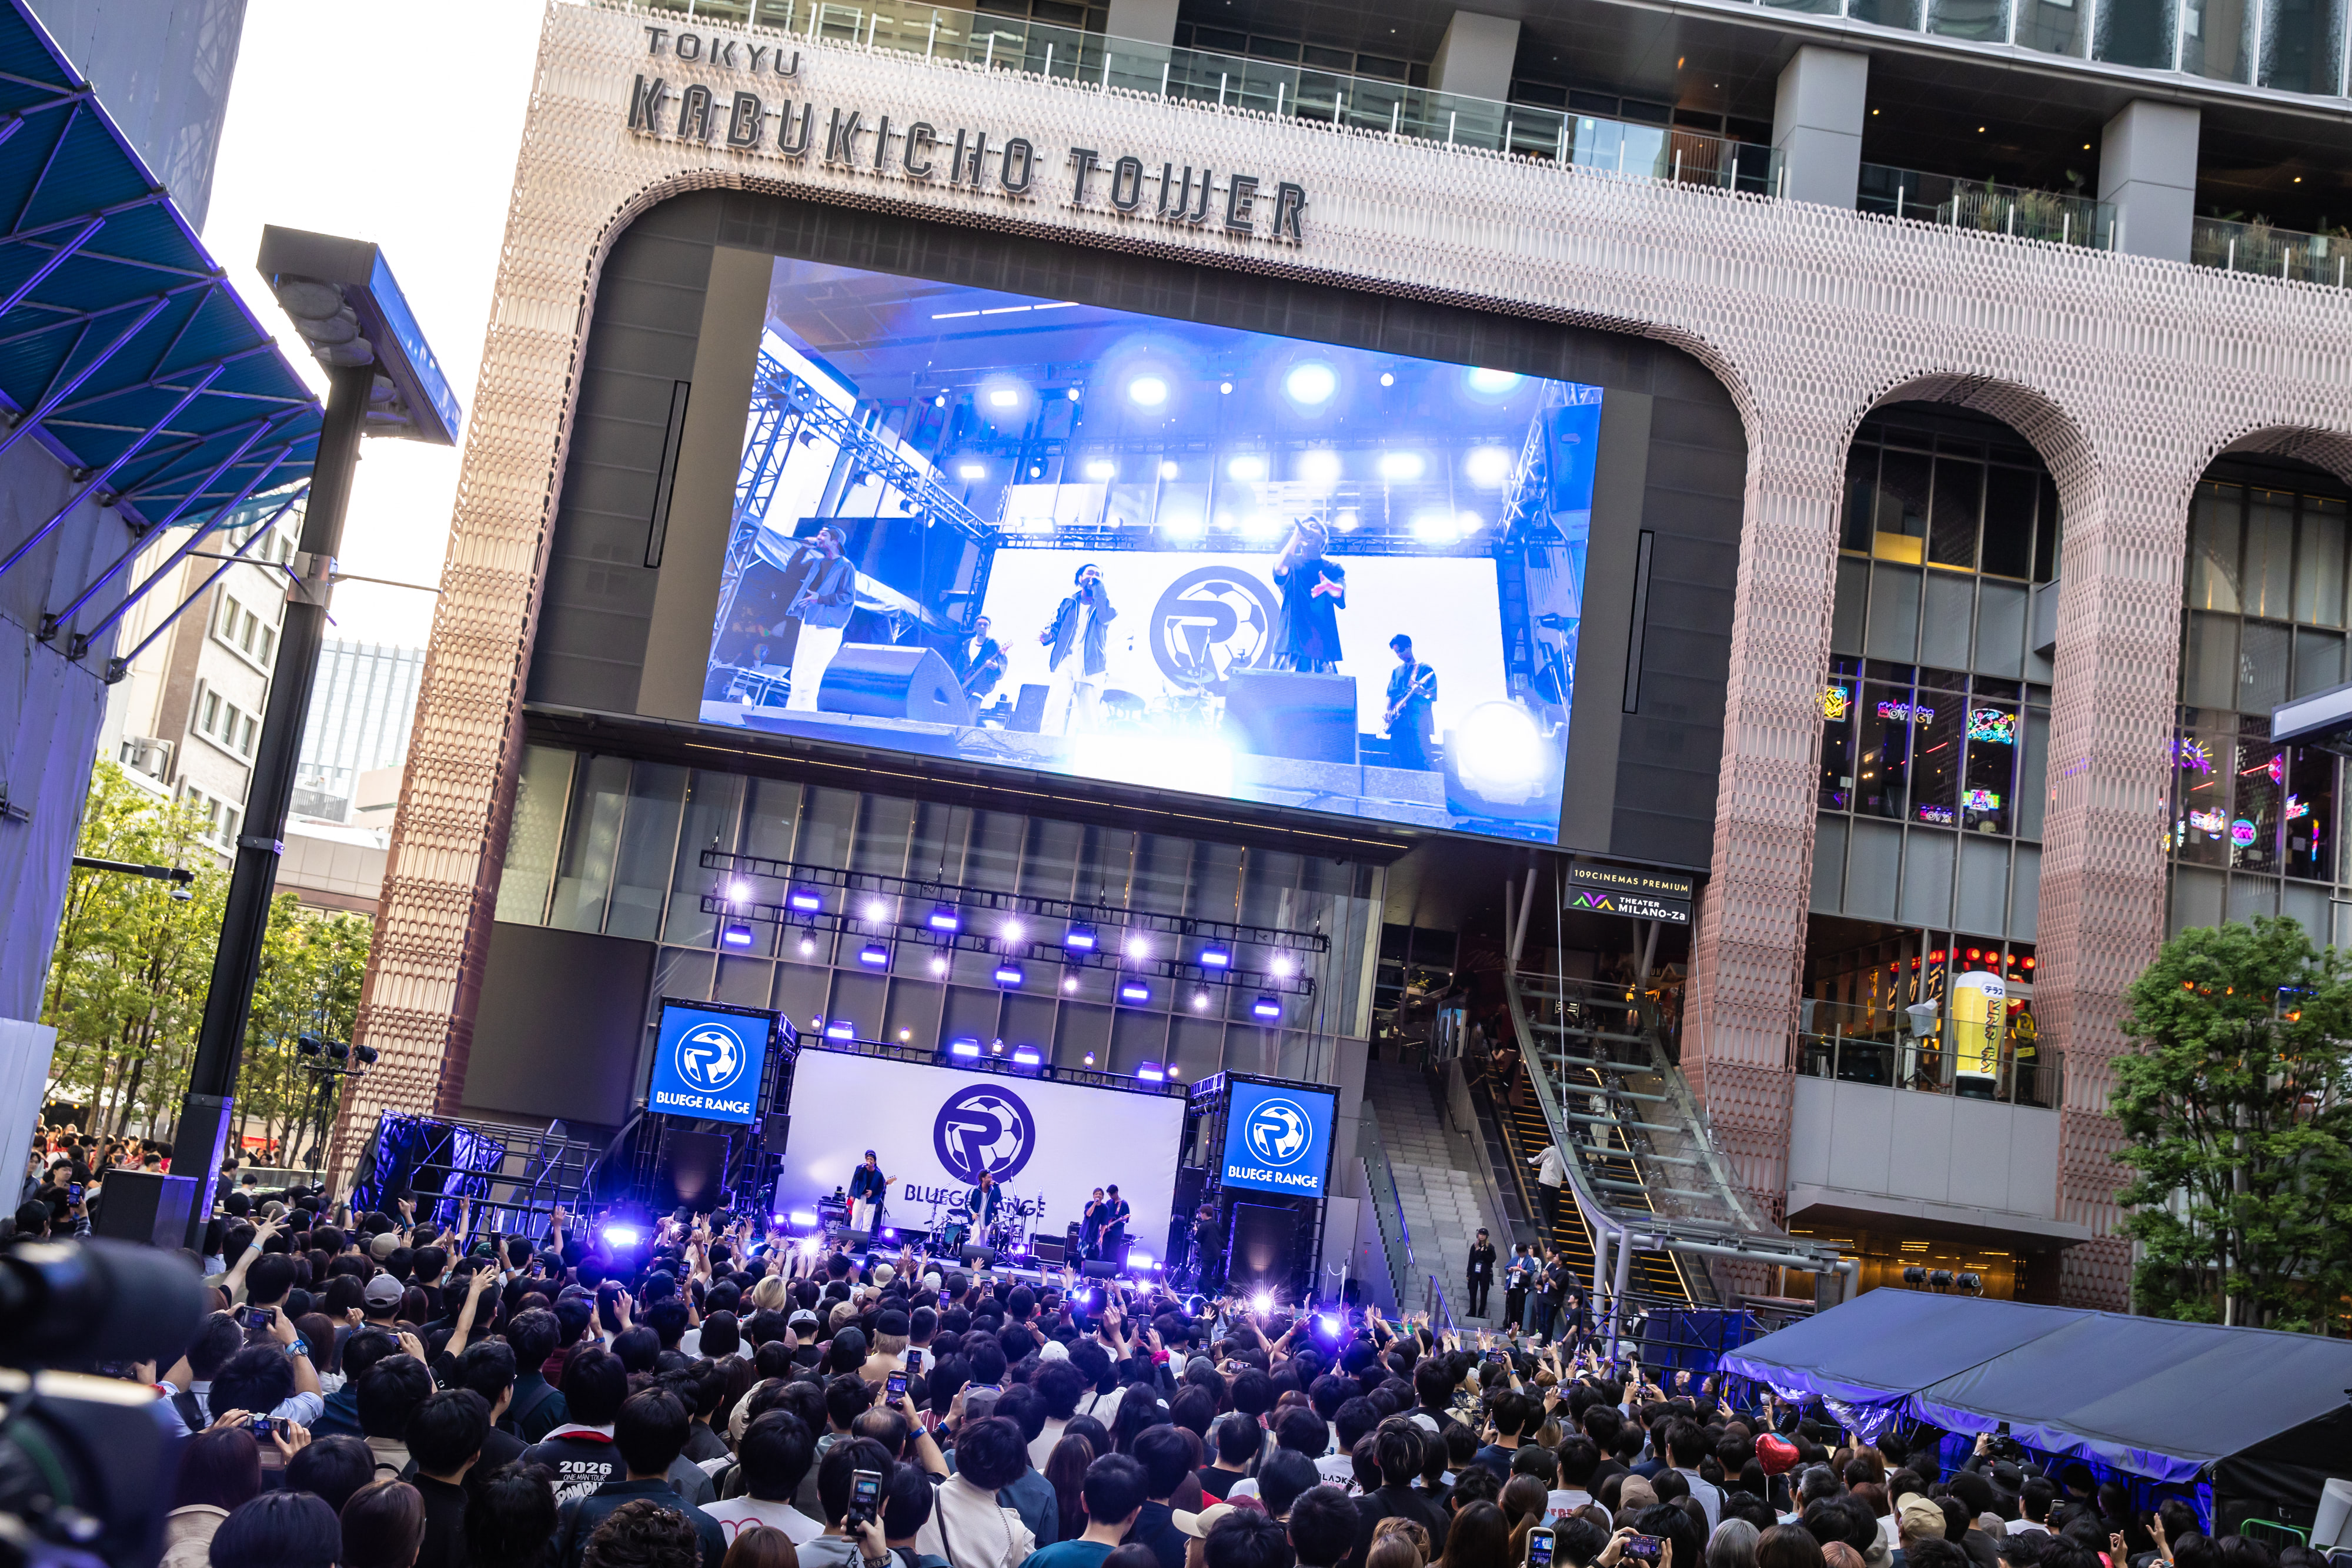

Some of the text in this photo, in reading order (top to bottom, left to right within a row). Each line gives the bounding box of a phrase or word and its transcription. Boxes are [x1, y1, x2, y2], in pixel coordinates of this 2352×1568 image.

[644, 26, 800, 78] TOKYU
[627, 74, 1306, 240] KABUKICHO TOWER
[1574, 870, 1688, 892] 109CINEMAS PREMIUM
[1618, 904, 1685, 921] MILANO-Za
[1619, 897, 1660, 908] THEATER
[1984, 986, 2003, 995] テラス
[656, 1091, 750, 1114] BLUEGE RANGE
[1228, 1165, 1318, 1188] BLUEGE RANGE
[904, 1184, 1046, 1218] BLUEG ANGE
[559, 1461, 612, 1475] 2026
